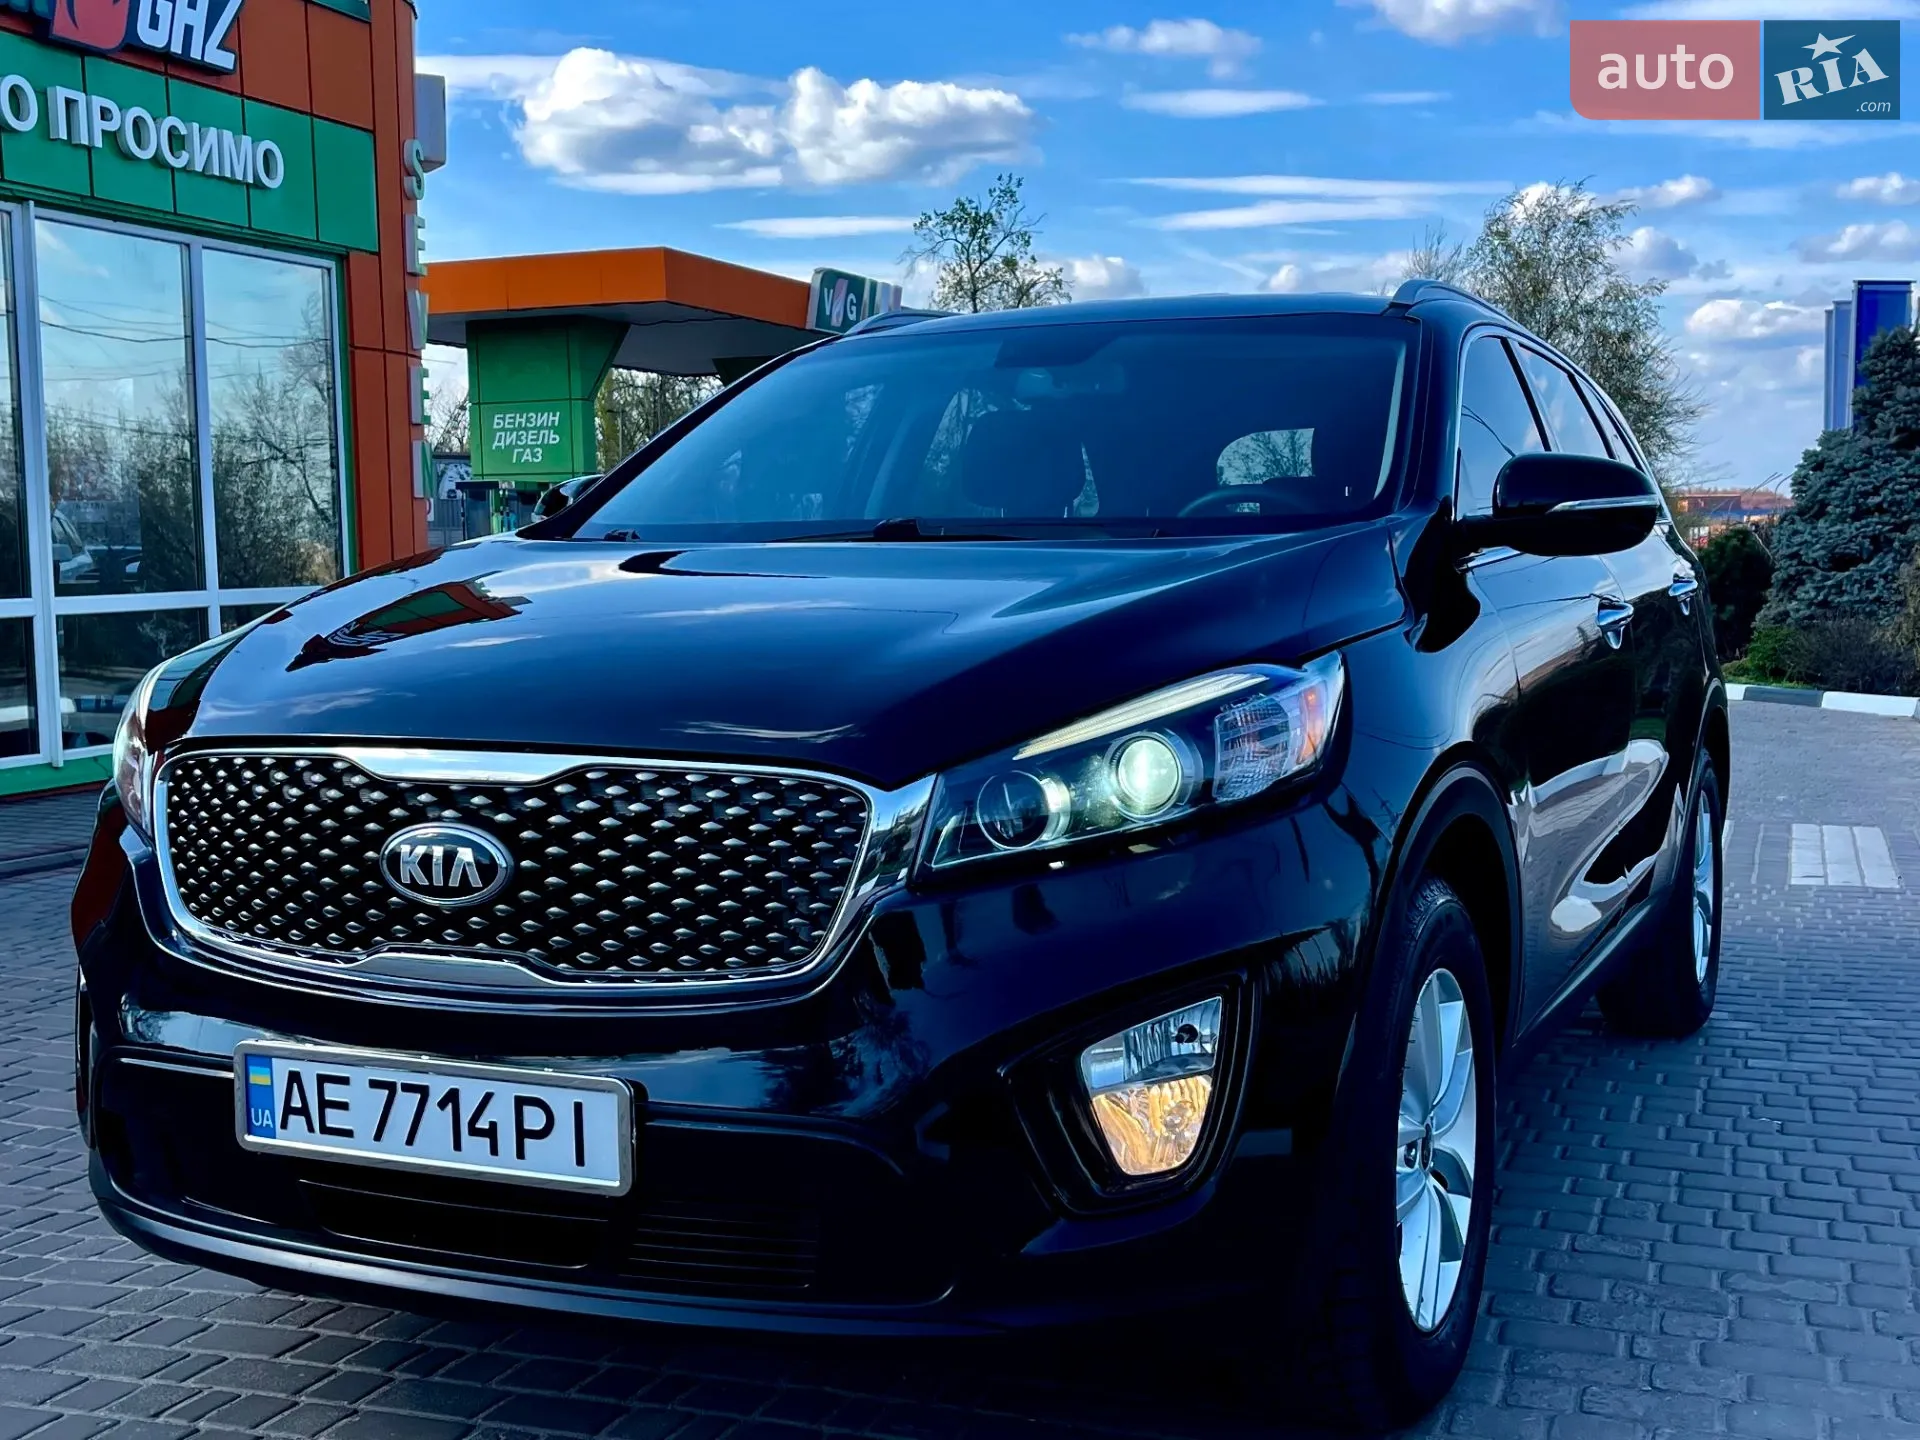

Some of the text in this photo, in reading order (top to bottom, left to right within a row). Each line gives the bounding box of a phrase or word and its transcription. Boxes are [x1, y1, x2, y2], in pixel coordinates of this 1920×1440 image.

[47, 85, 285, 189] ПРОСИМО
[493, 411, 560, 429] БЕНЗИН
[492, 429, 560, 450] ДИЗЕЛЬ
[512, 447, 543, 463] ГАЗ
[400, 844, 483, 888] KIA
[251, 1107, 273, 1129] UA
